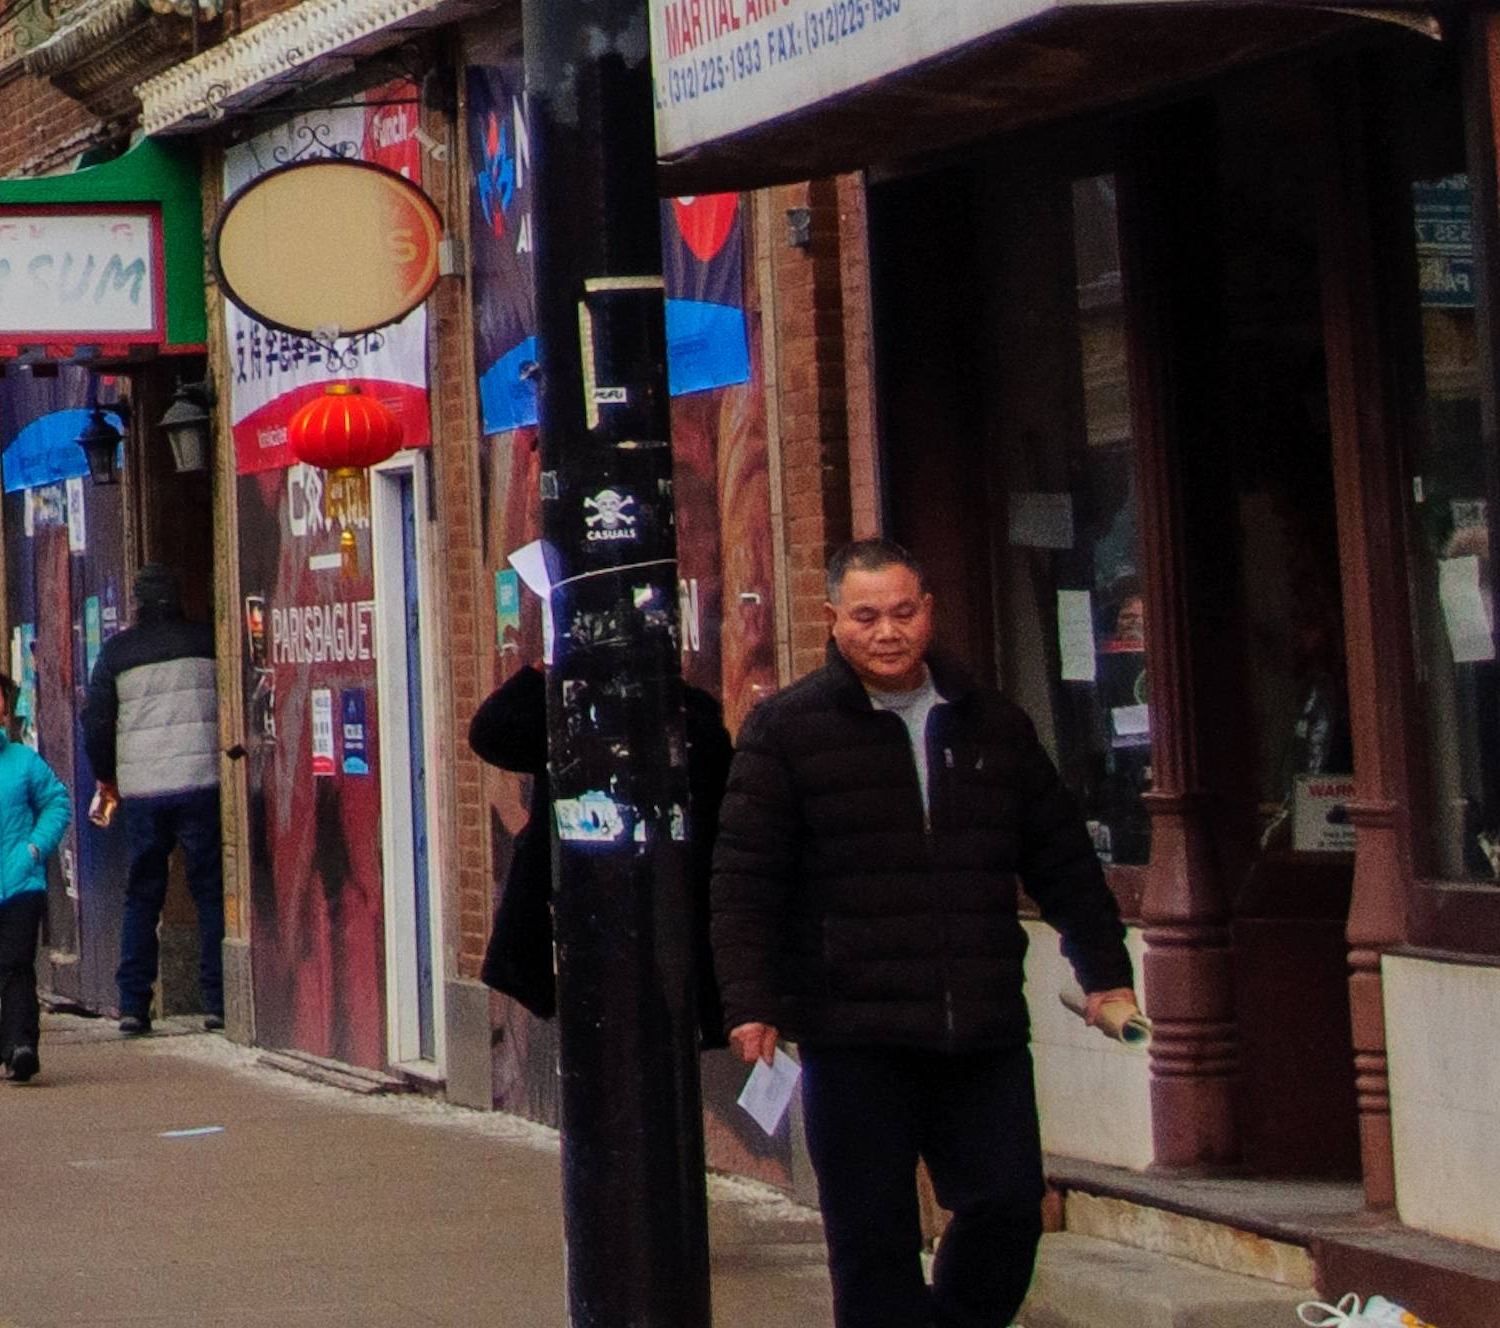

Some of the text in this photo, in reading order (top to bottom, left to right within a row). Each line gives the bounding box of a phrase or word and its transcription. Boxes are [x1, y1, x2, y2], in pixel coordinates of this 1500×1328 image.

[667, 59, 701, 110] (312)
[766, 22, 803, 66] FAX:
[586, 529, 637, 541] CASUALS
[1308, 783, 1356, 798] WARN
